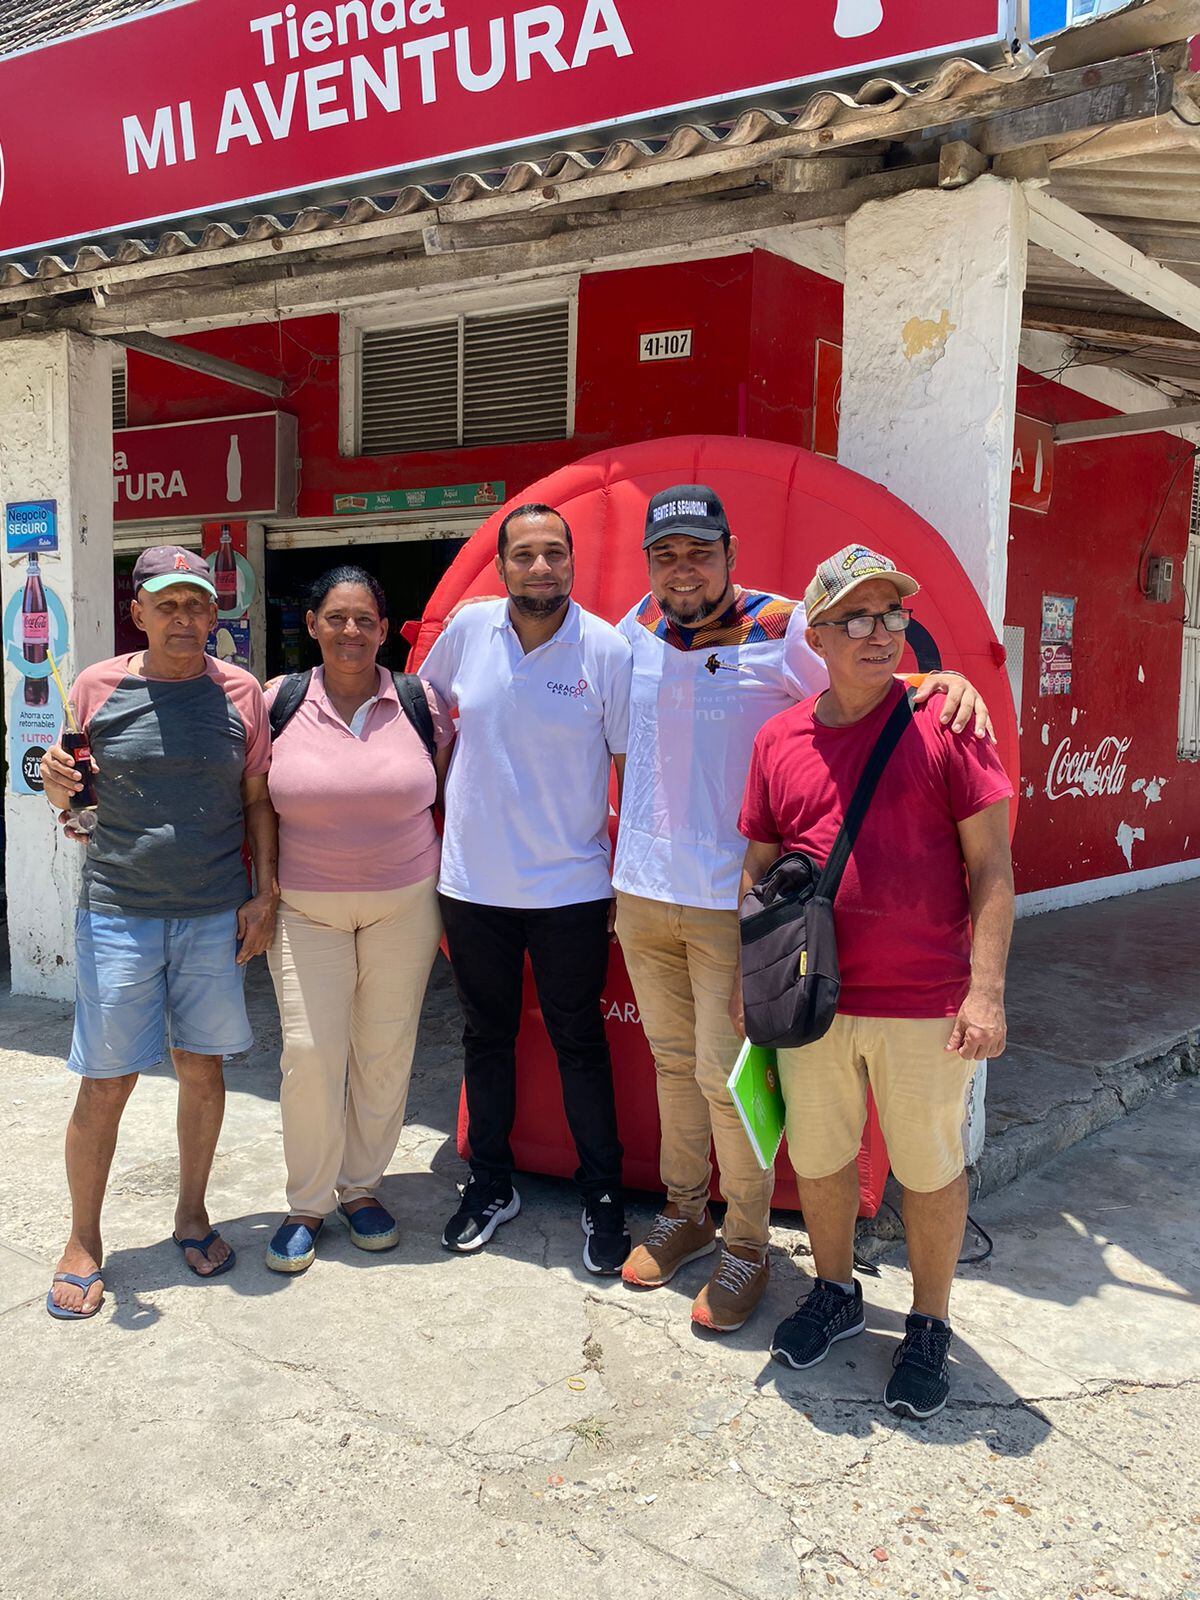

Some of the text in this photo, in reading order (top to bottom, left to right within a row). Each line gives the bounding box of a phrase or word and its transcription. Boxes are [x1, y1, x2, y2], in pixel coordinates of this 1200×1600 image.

[249, 0, 446, 66] Tienda
[122, 0, 634, 175] MI AVENTURA
[644, 334, 688, 356] 41-107
[8, 509, 48, 524] Negocio
[8, 521, 48, 535] SEGURO
[174, 554, 191, 570] A
[546, 678, 588, 698] CARACOL
[19, 711, 40, 720] Ahorra
[18, 720, 55, 729] retornables
[26, 733, 54, 744] LITRO
